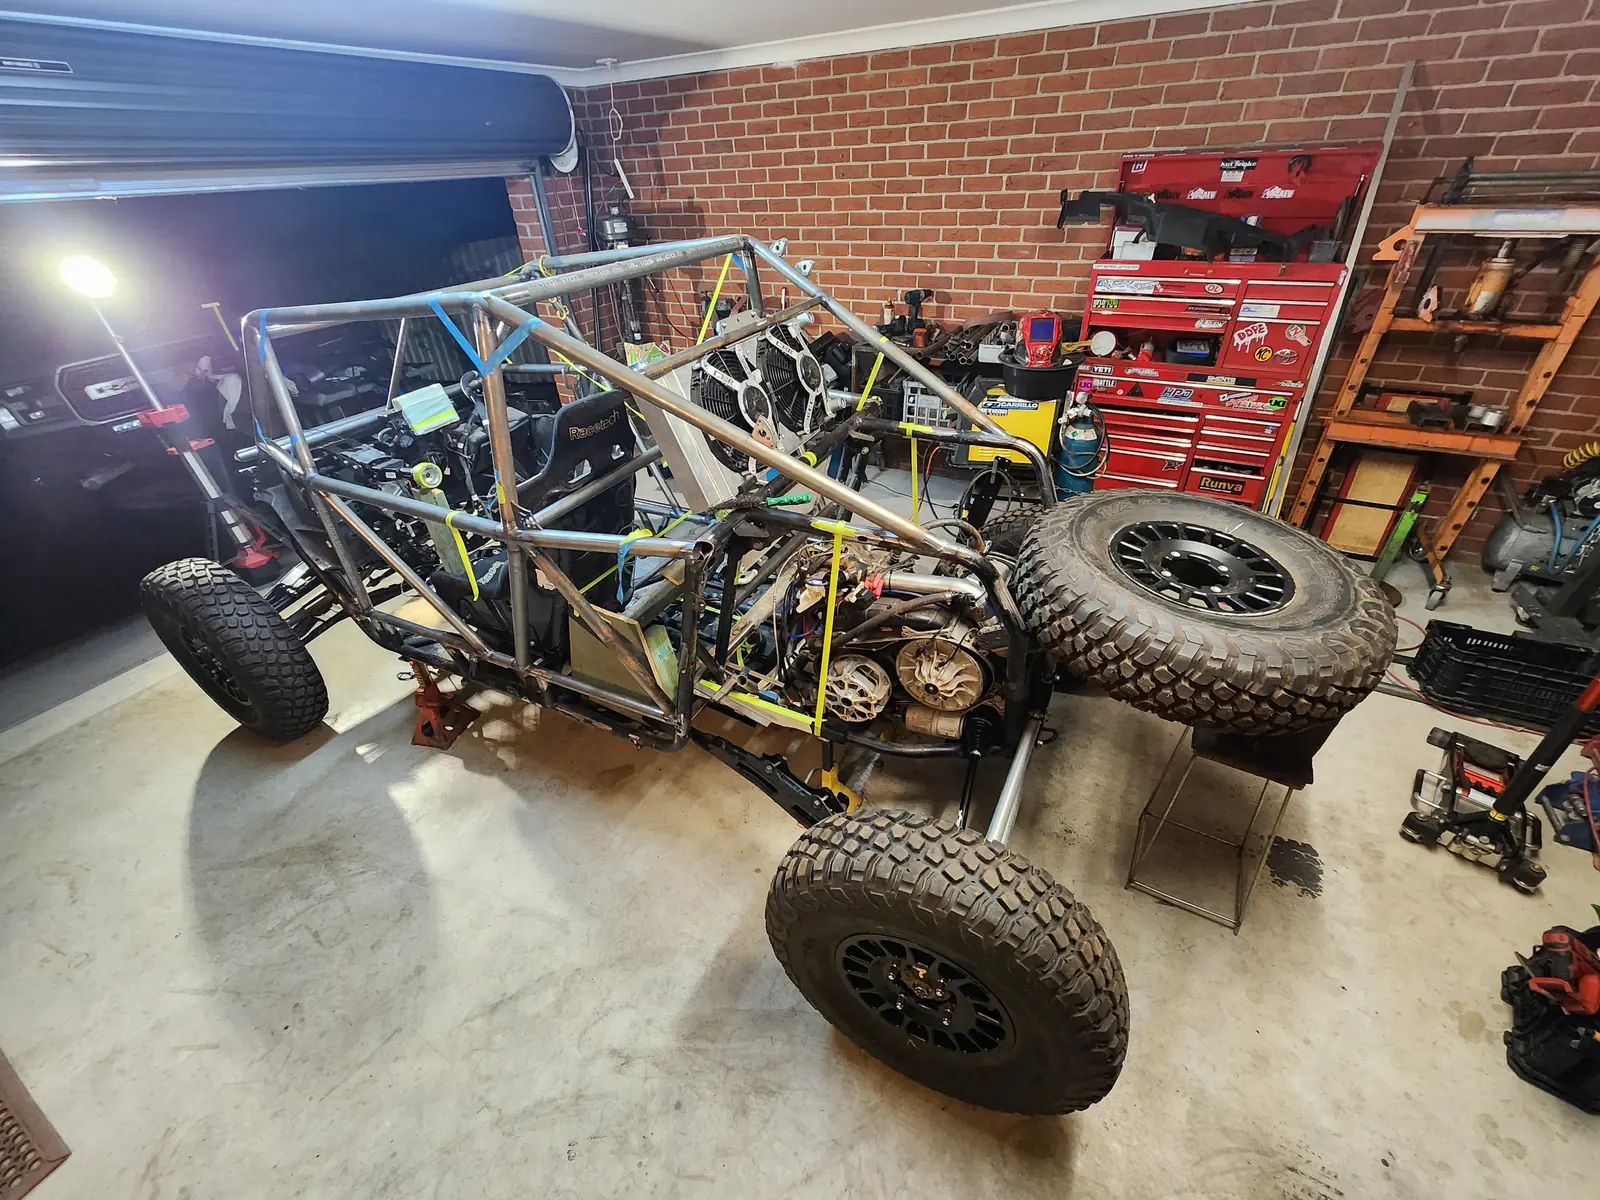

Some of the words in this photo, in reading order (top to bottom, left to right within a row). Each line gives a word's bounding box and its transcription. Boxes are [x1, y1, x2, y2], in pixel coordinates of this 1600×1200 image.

[1236, 322, 1267, 341] DOPE
[1255, 346, 1271, 361] KC
[1093, 365, 1112, 374] YETI
[1162, 386, 1194, 399] HPD
[1001, 401, 1038, 409] CARRILLO
[568, 409, 620, 441] Racetech
[1200, 476, 1243, 492] Runva
